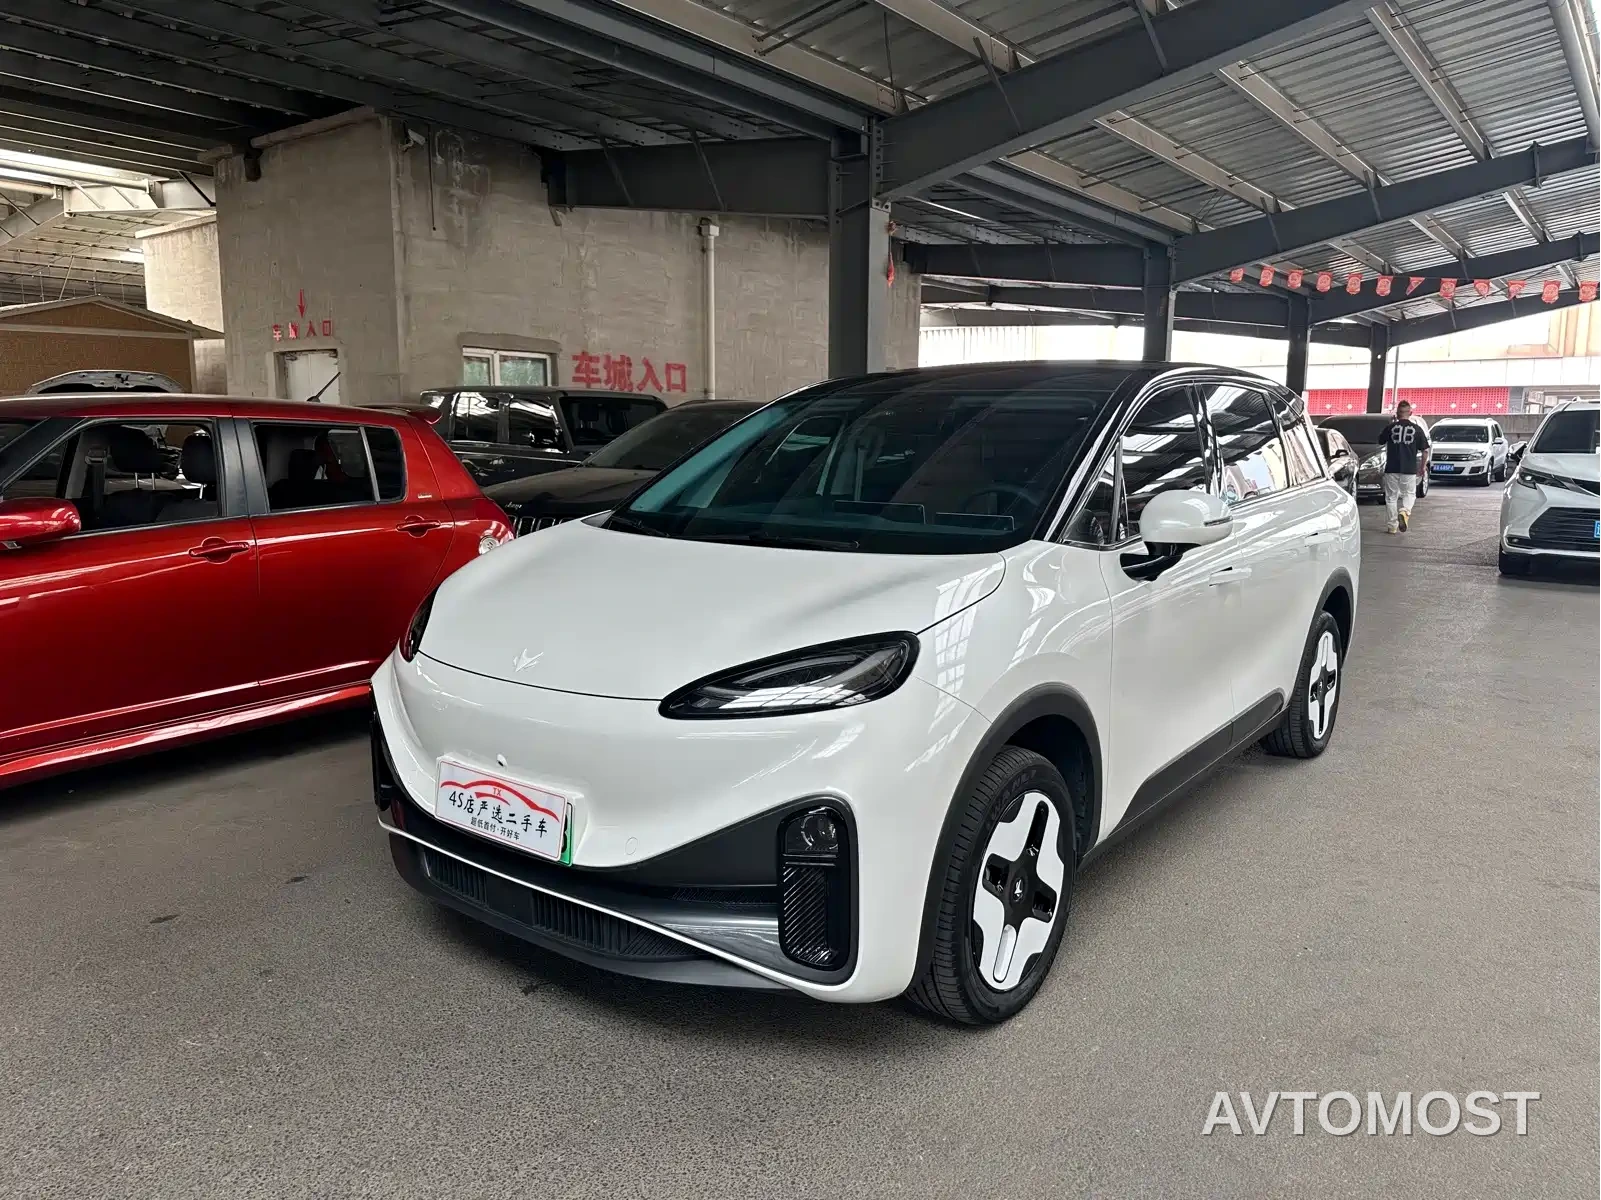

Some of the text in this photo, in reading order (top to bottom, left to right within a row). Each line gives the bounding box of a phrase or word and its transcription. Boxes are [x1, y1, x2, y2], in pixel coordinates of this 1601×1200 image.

[572, 350, 687, 392] 车城入口
[492, 787, 502, 797] TX
[448, 790, 548, 839] 4S店严选二手车
